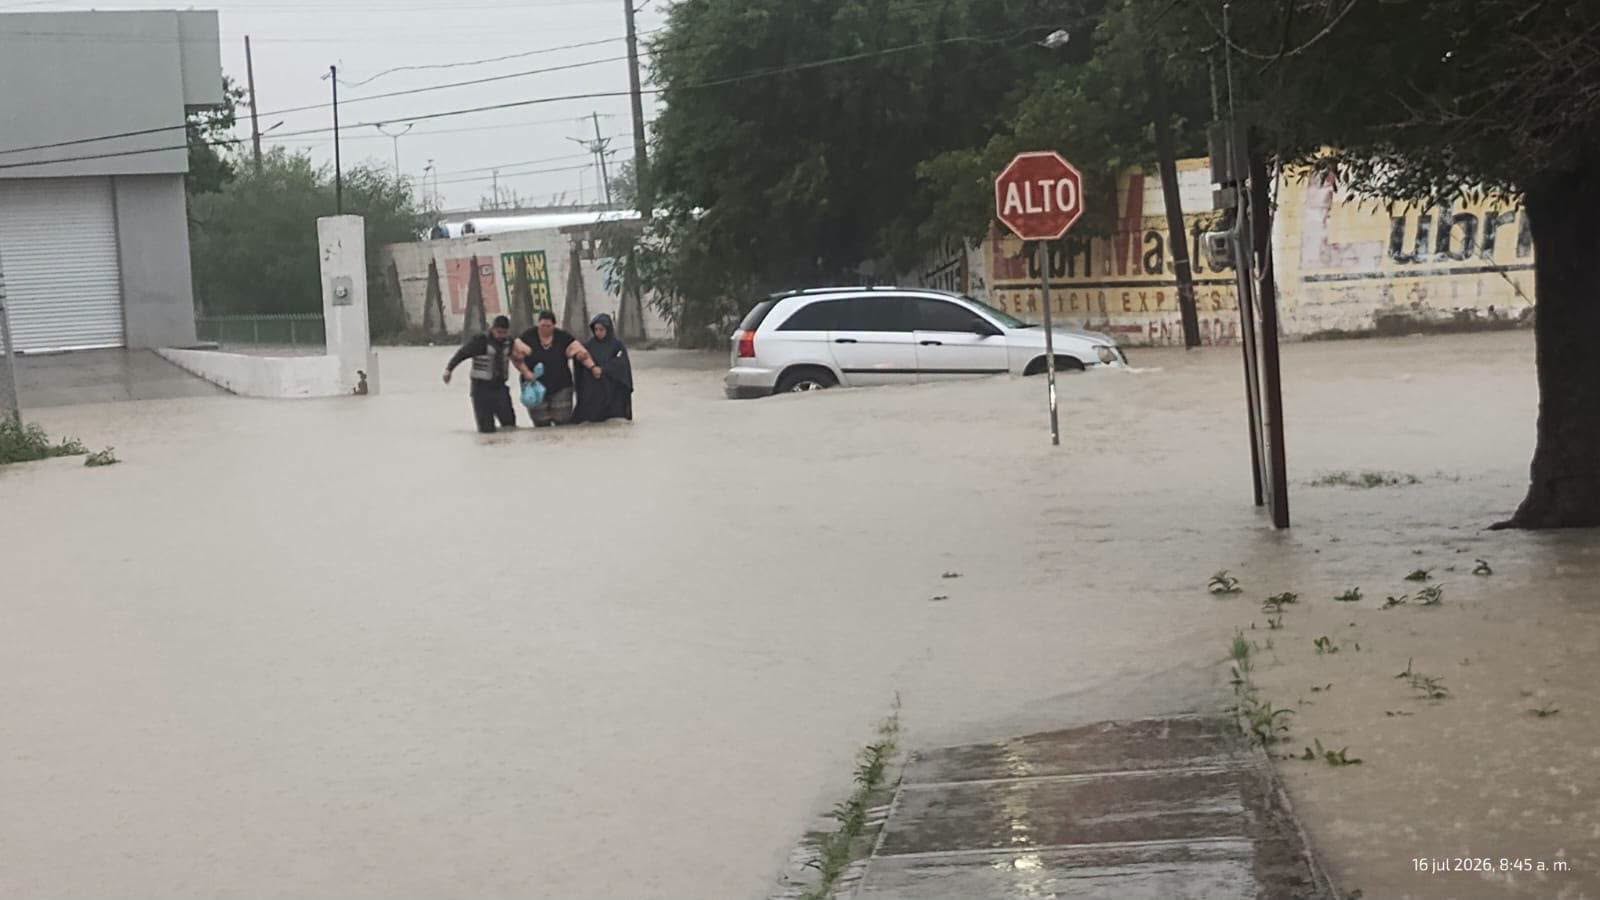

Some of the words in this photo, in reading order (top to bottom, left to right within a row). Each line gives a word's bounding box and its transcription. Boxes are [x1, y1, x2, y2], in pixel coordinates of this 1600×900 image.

[1003, 178, 1075, 216] ALTO
[504, 253, 546, 281] MNN
[998, 291, 1107, 312] SERICIO
[1148, 317, 1240, 346] ENTADA
